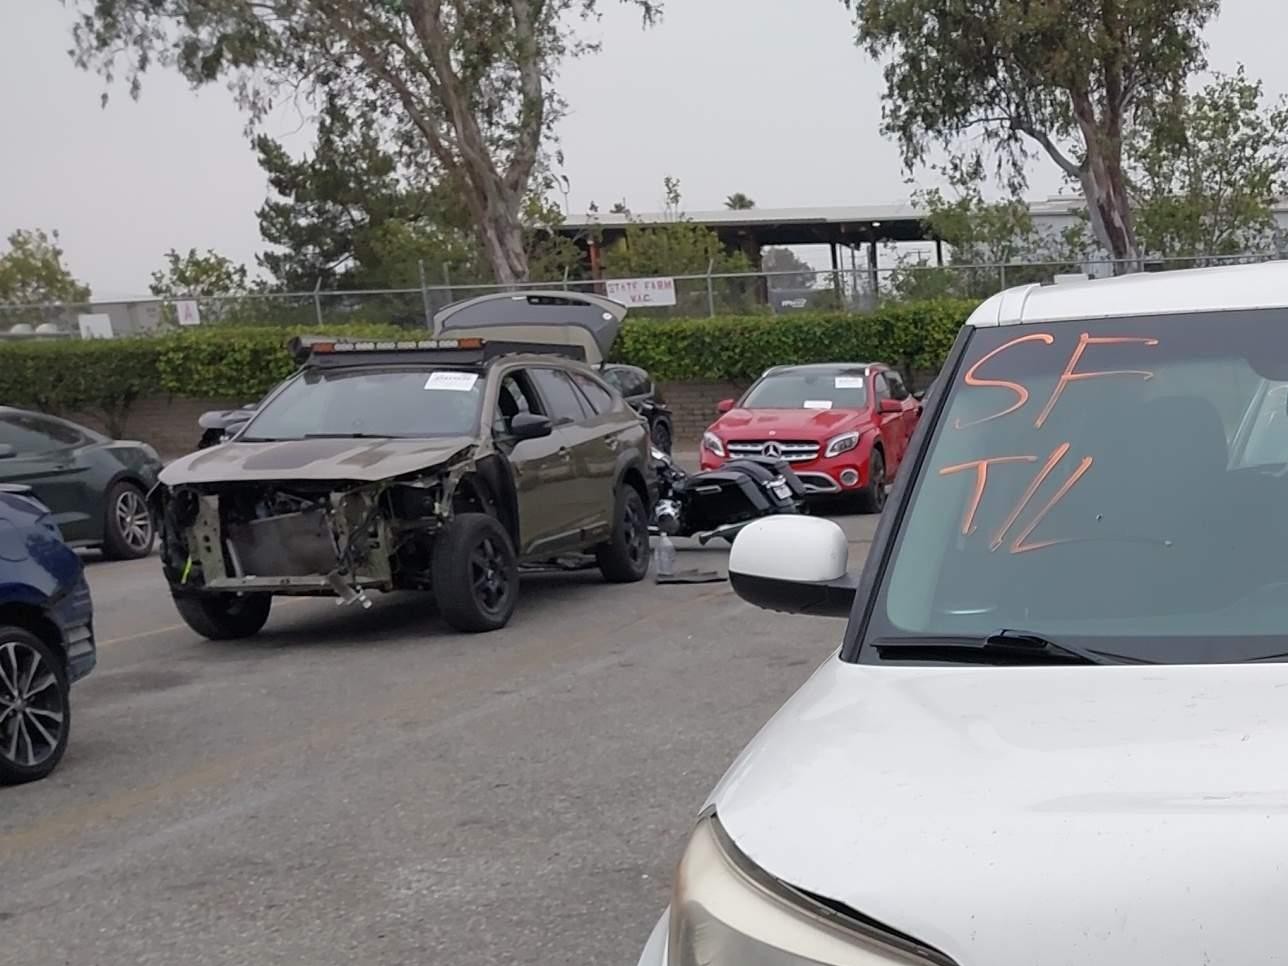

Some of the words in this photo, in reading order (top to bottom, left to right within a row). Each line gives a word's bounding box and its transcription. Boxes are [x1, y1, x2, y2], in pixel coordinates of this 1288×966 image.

[607, 281, 638, 294] STATE
[644, 280, 672, 290] FARM
[955, 332, 1159, 429] SF
